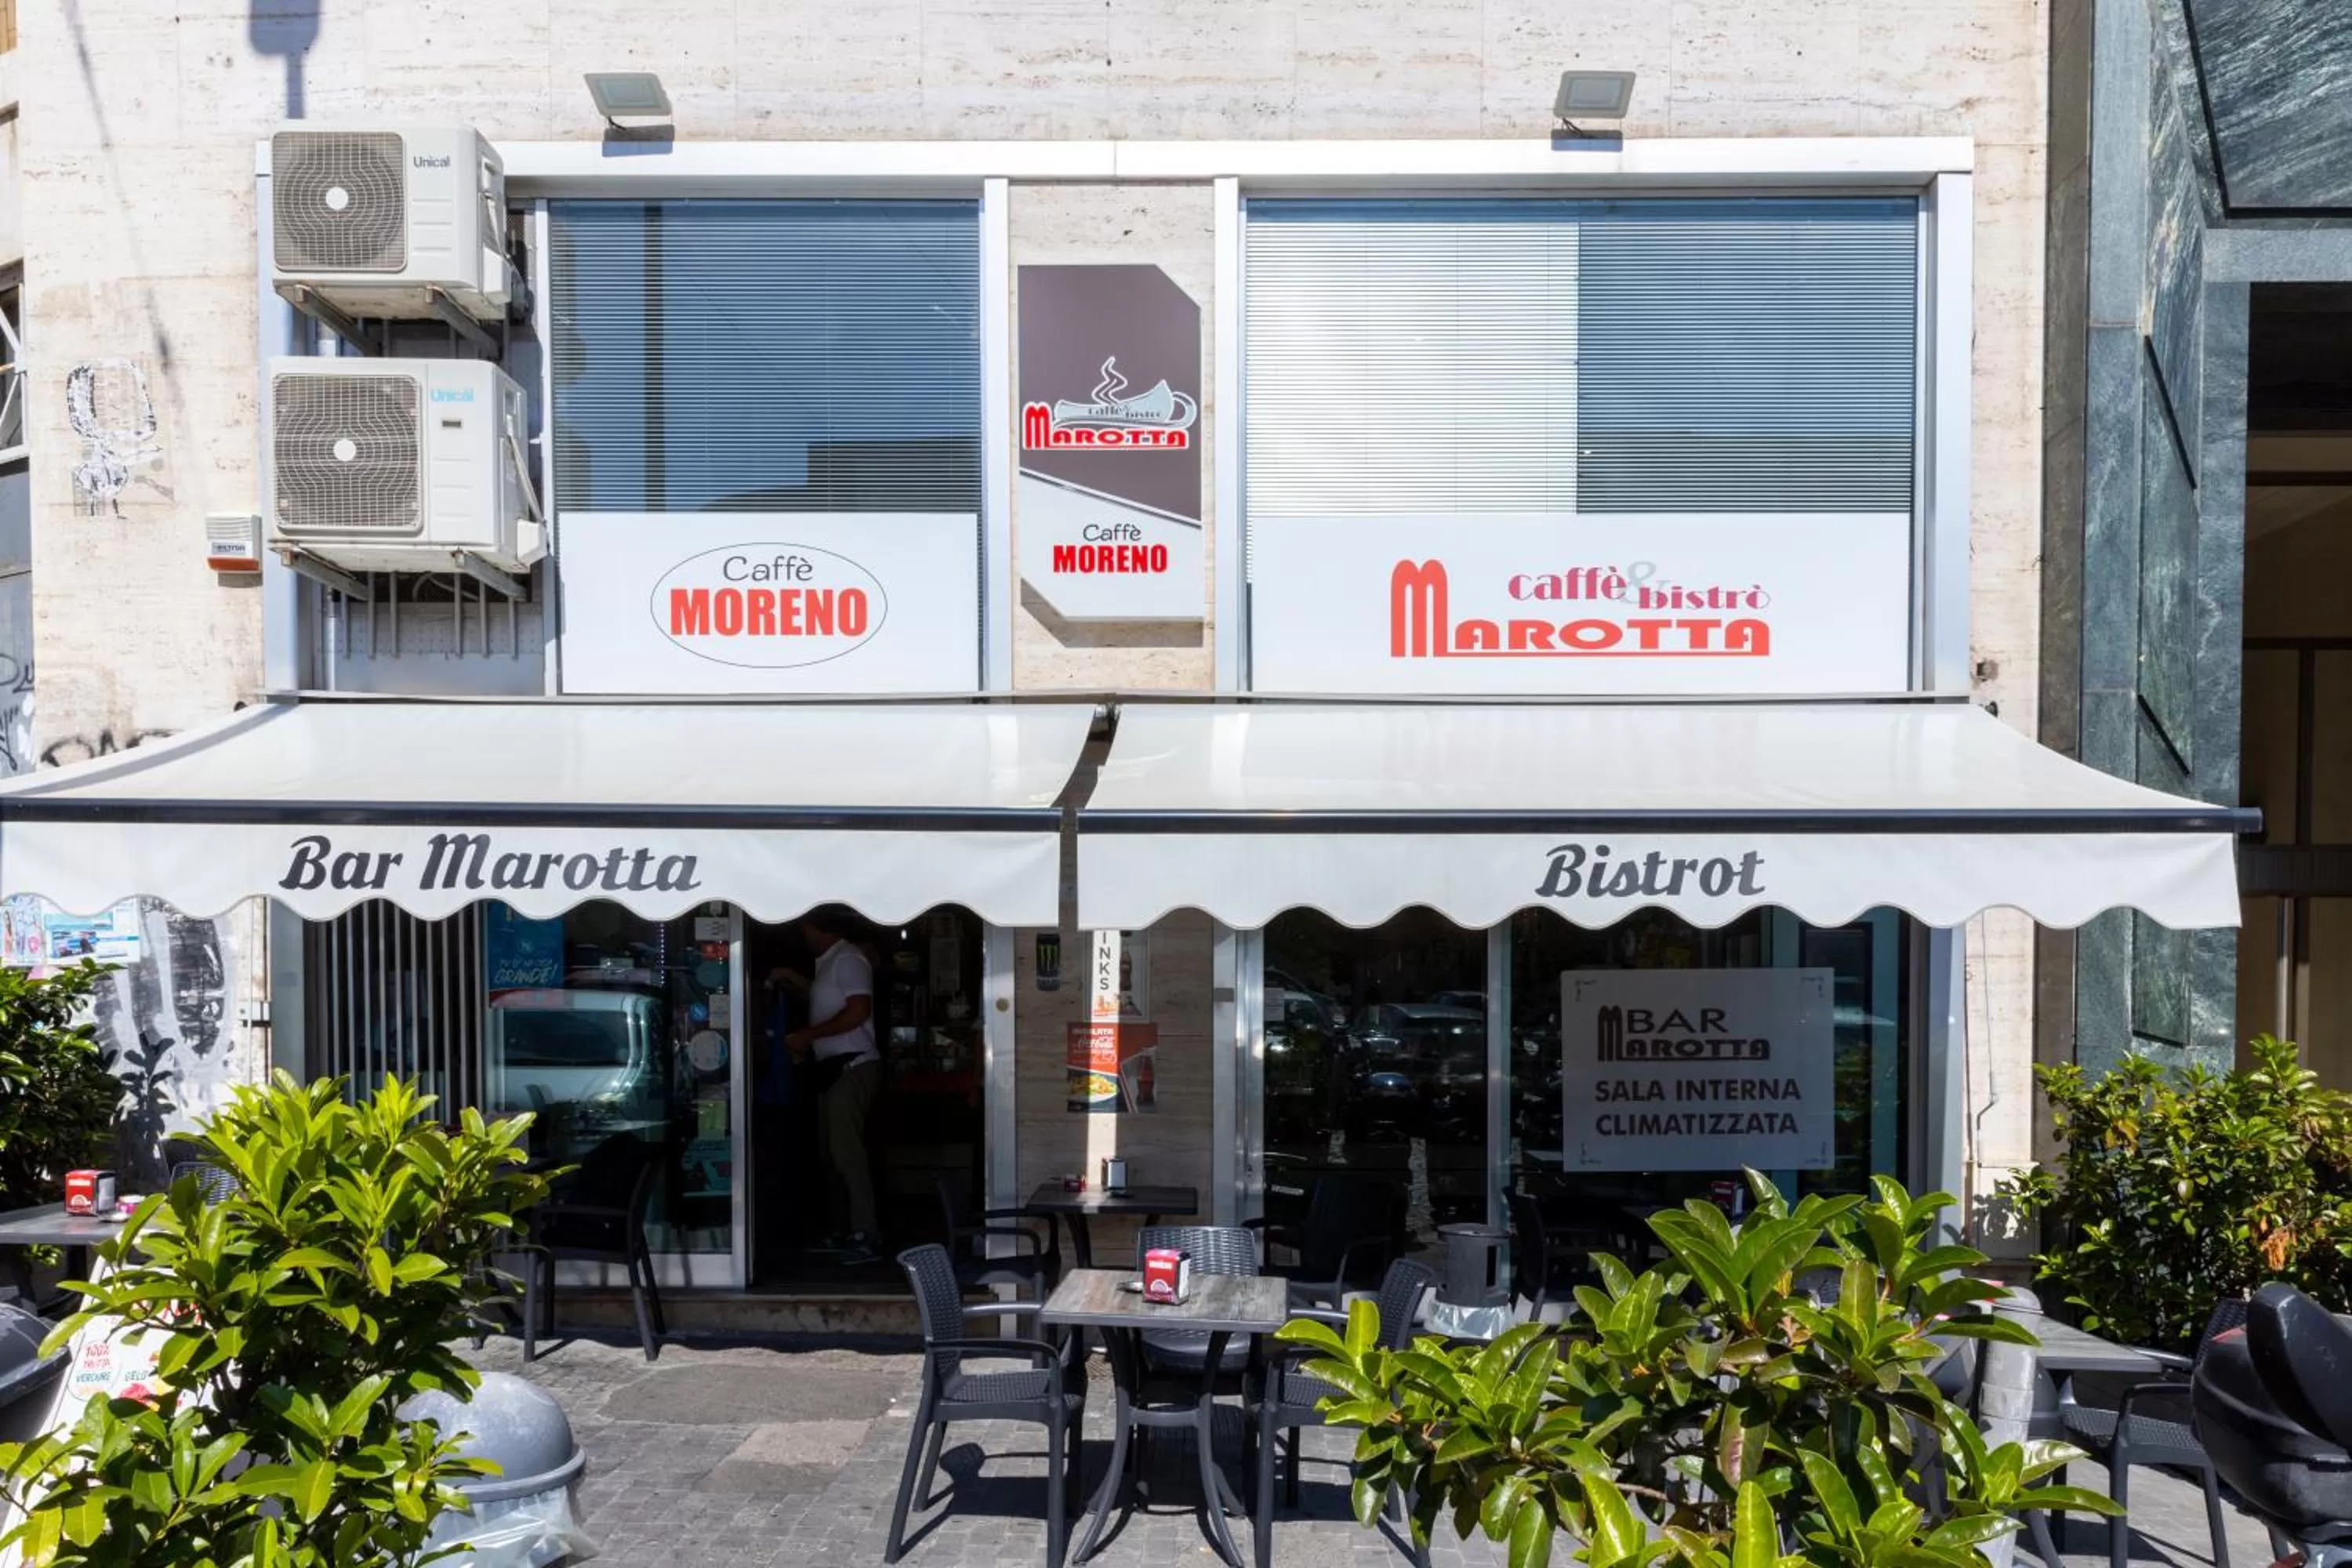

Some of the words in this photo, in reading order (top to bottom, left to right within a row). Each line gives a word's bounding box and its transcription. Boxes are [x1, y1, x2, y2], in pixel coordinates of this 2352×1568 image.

[413, 154, 450, 168] Unical
[430, 388, 474, 402] Unical
[1082, 523, 1142, 542] Caffè
[723, 555, 814, 583] Caffè
[1052, 543, 1169, 574] MORENO
[1508, 566, 1627, 601] caffè
[1638, 584, 1771, 610] bistrò
[670, 586, 868, 637] MORENO
[1390, 558, 1770, 659] MAROTTA
[278, 835, 403, 891] Bar
[419, 833, 702, 892] Marotta
[1534, 844, 1766, 898] Bistrot
[1099, 931, 1111, 990] INKS
[1597, 1004, 1770, 1062] MAROTTA
[1626, 1008, 1728, 1033] BAR
[1595, 1080, 1664, 1102] SALA
[1675, 1078, 1802, 1101] INTERNA
[1595, 1112, 1798, 1136] CLIMATIZZATA
